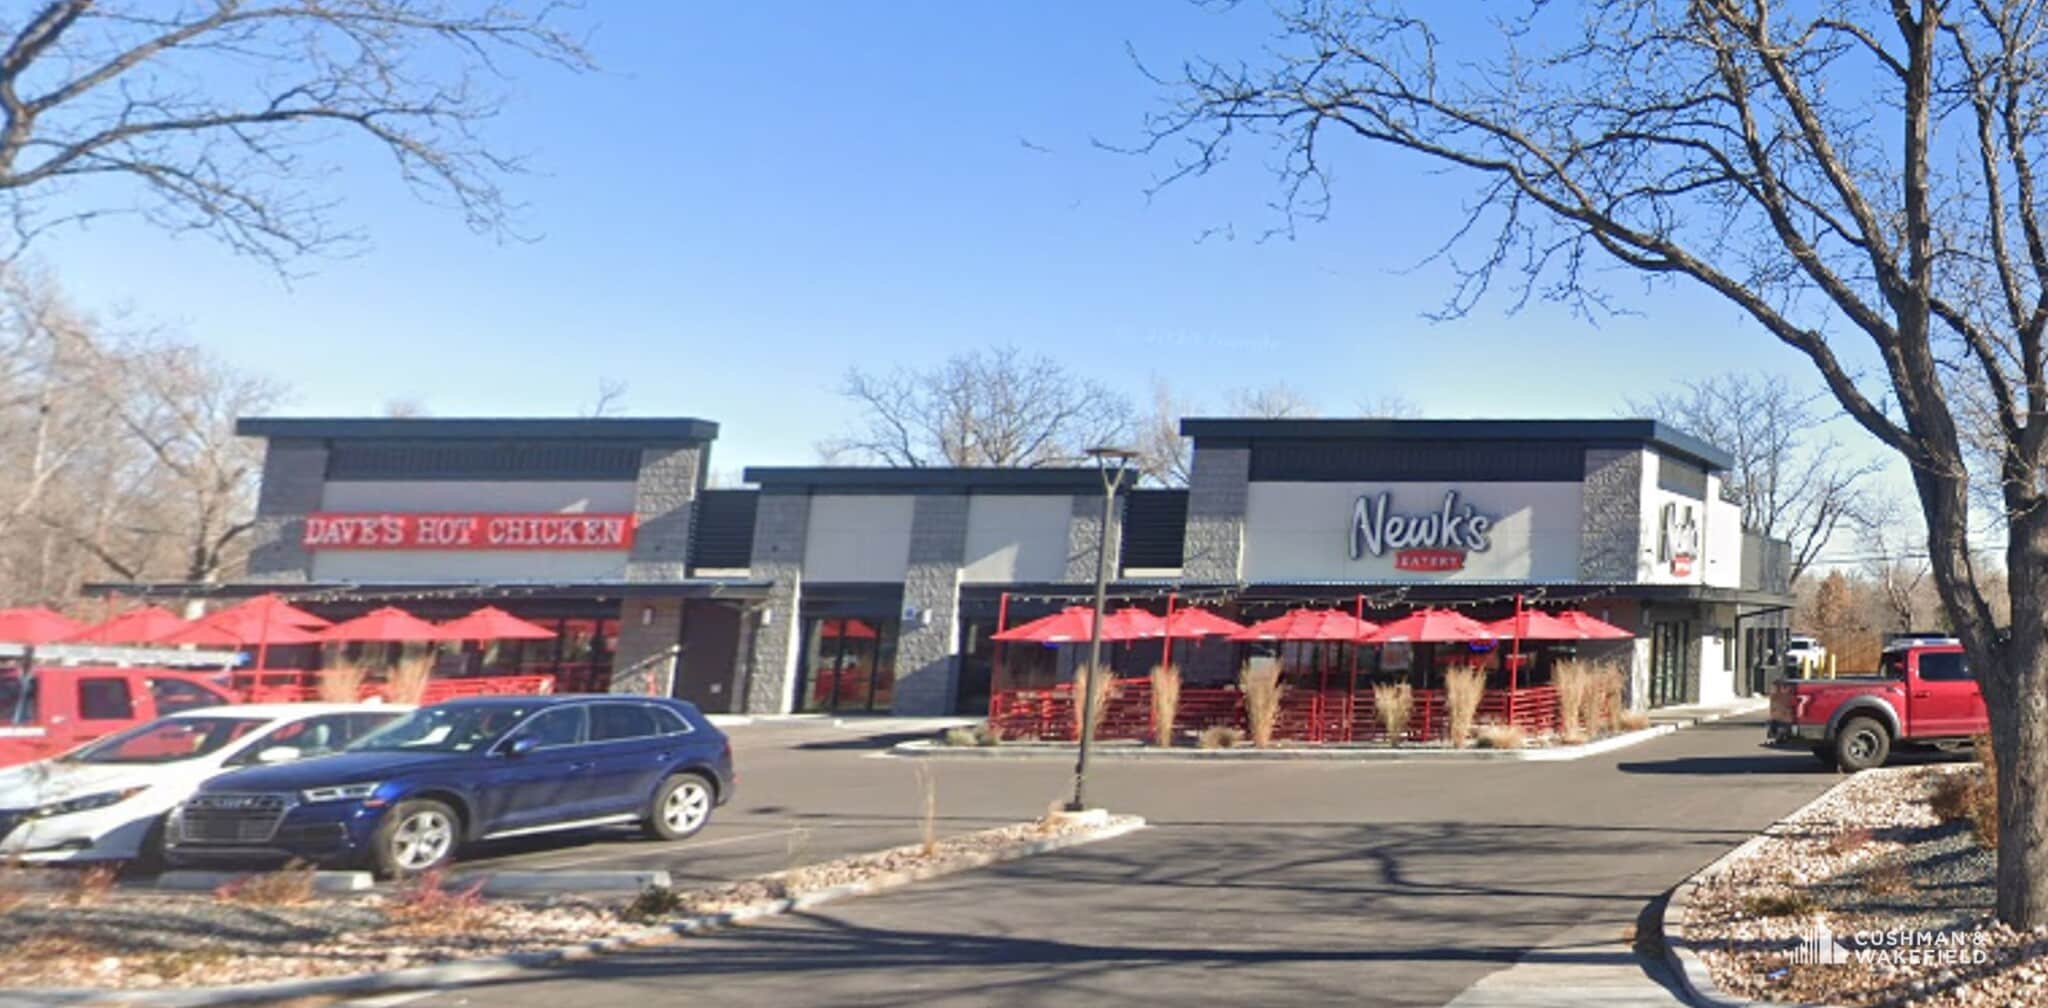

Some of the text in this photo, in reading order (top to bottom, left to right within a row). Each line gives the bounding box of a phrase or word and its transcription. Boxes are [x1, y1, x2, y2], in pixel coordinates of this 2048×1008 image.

[303, 515, 627, 545] DAVE'S HOT CHICKEN
[1349, 489, 1490, 560] Newk's
[1401, 555, 1458, 567] EATERY
